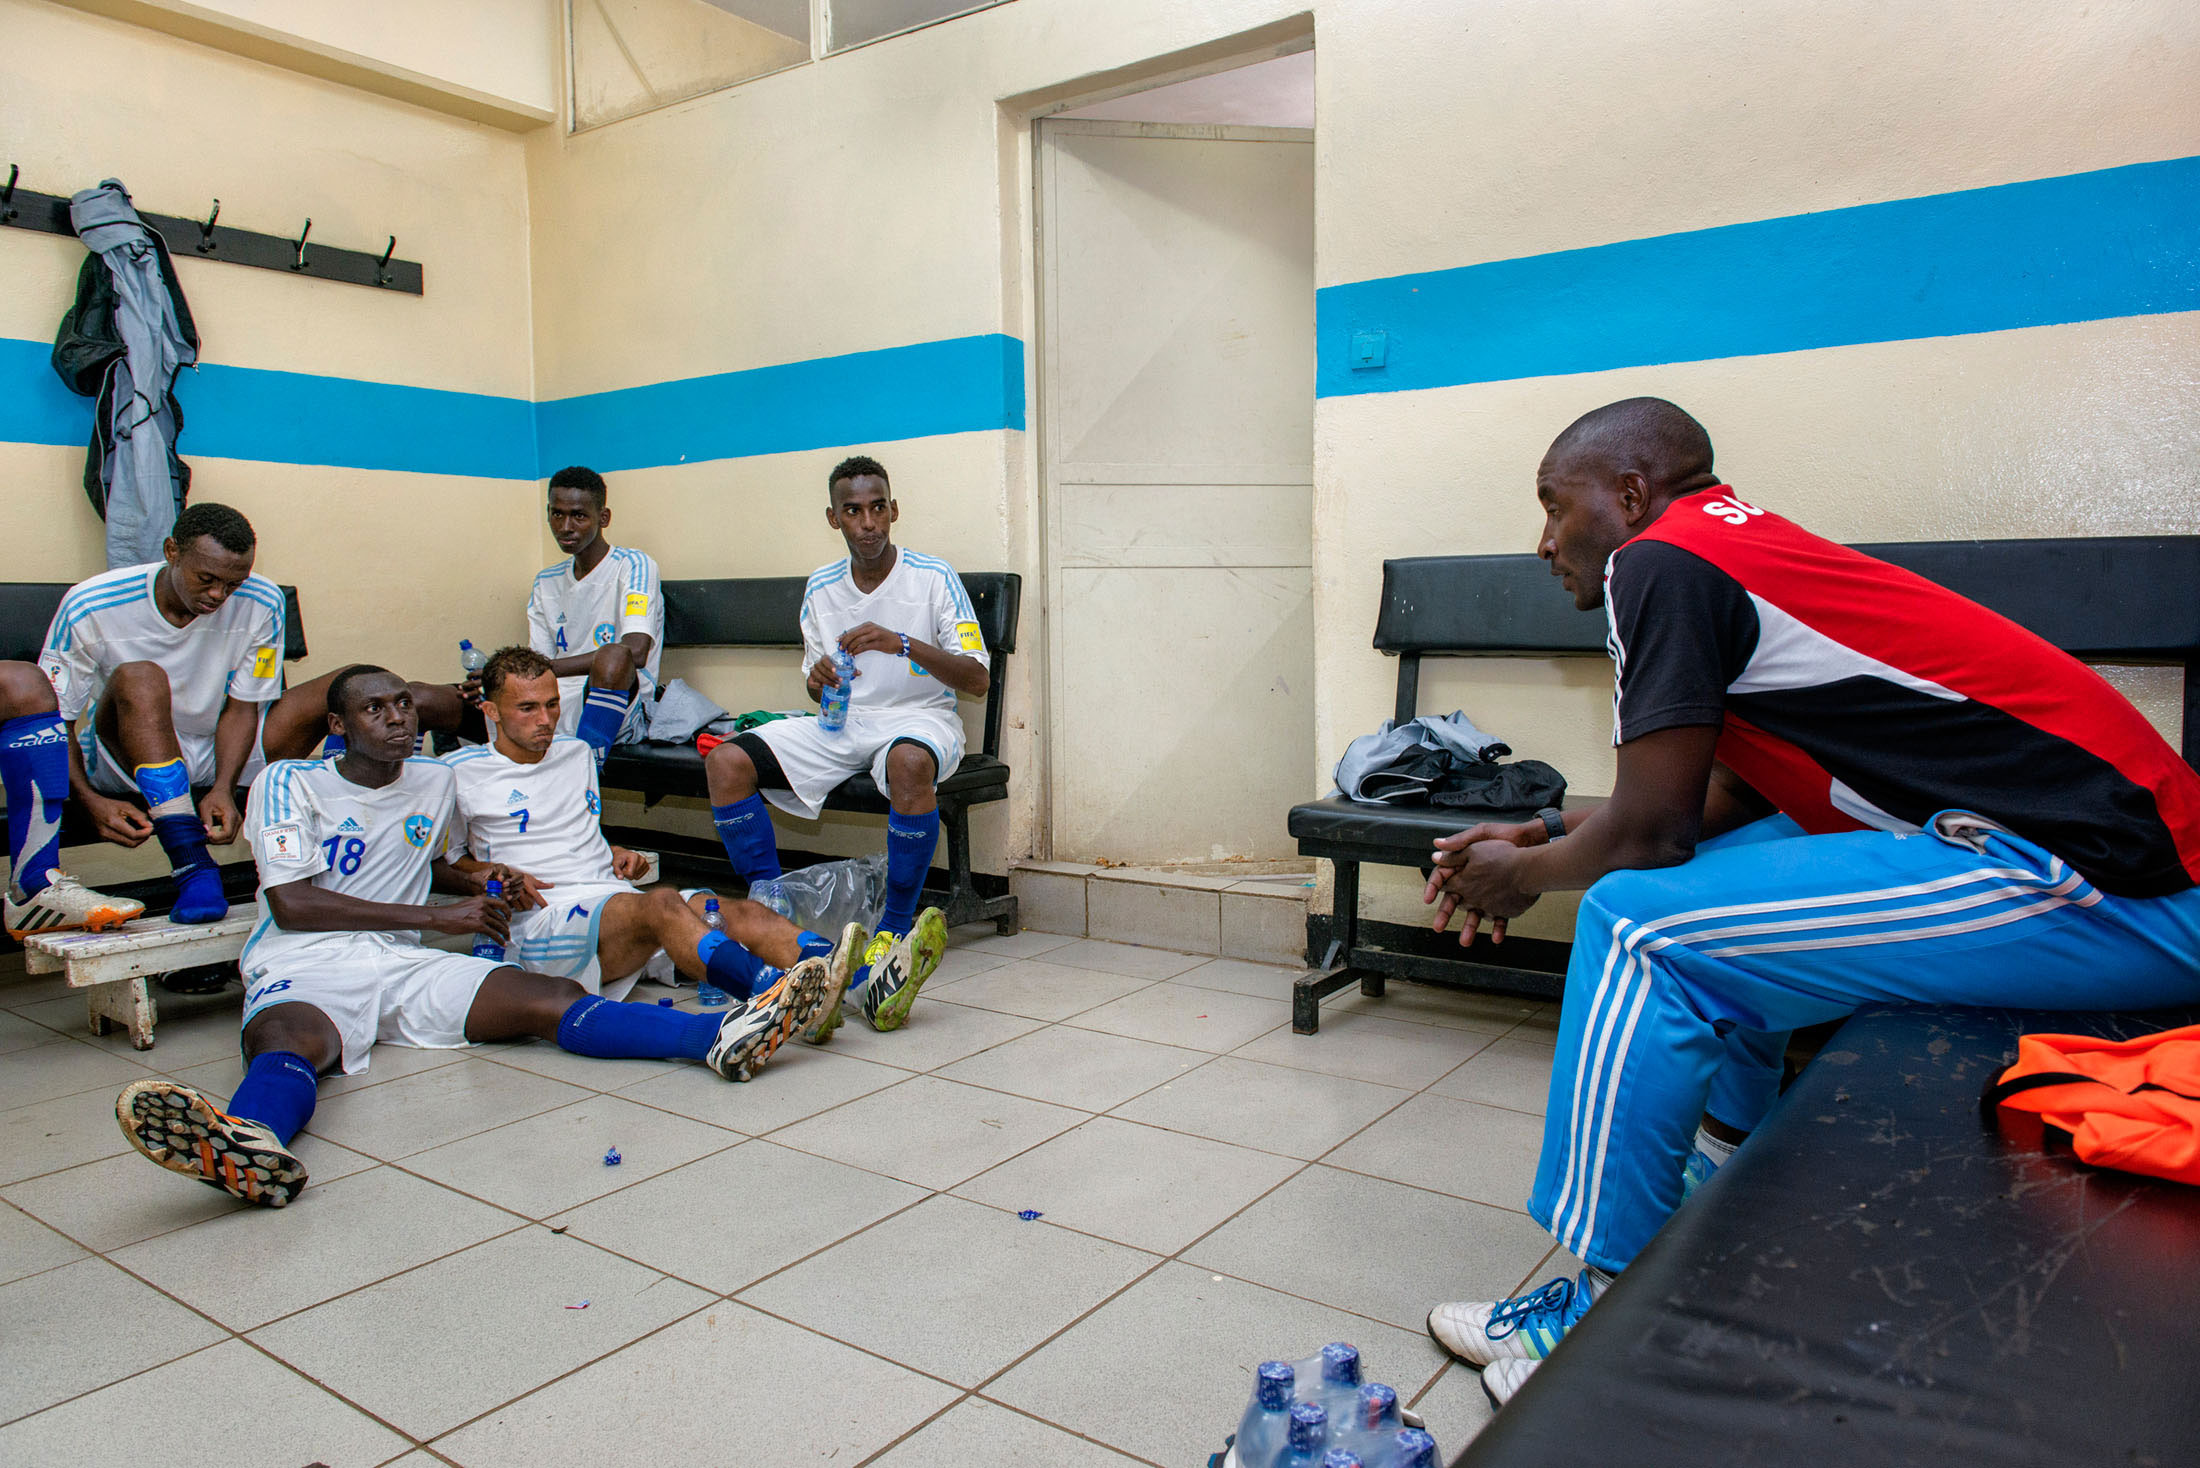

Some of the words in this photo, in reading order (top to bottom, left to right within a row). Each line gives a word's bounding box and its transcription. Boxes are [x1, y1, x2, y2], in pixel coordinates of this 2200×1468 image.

[555, 626, 569, 652] 4
[509, 808, 530, 834] 7
[321, 834, 366, 877] 18
[249, 979, 292, 1005] 18
